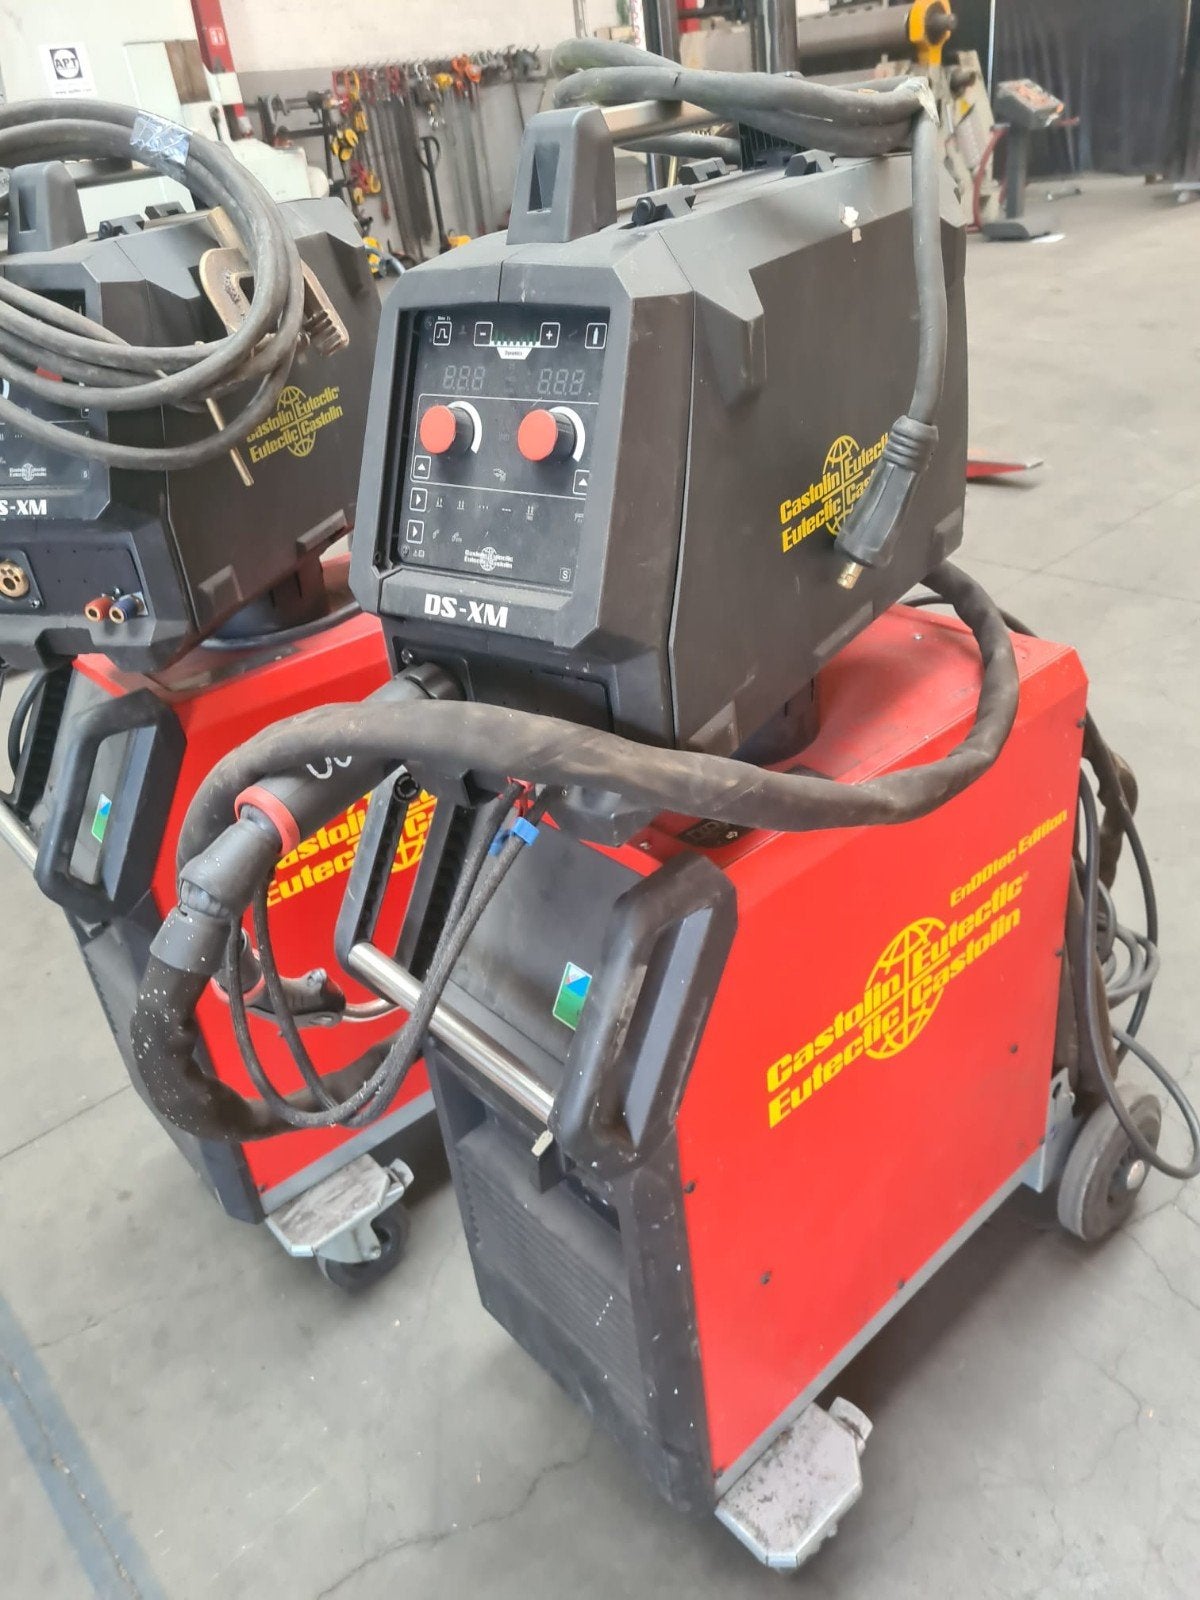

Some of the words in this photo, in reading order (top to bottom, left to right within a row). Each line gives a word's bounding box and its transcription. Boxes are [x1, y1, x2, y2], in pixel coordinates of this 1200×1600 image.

[55, 57, 77, 68] APT
[294, 387, 339, 417] Eutectic
[249, 428, 299, 463] Eutectic
[301, 405, 344, 436] Castolin
[0, 499, 48, 516] S-XM
[780, 471, 841, 525] Castolin
[782, 498, 842, 553] Eutectic
[562, 570, 569, 580] S
[424, 593, 509, 629] DS-XM
[276, 809, 367, 871] astoli
[1018, 809, 1067, 855] Edition
[766, 973, 901, 1093] Castolin
[912, 876, 1023, 977] Eutectic
[768, 1006, 900, 1130] Eutectic
[911, 908, 1021, 1009] Castolin
